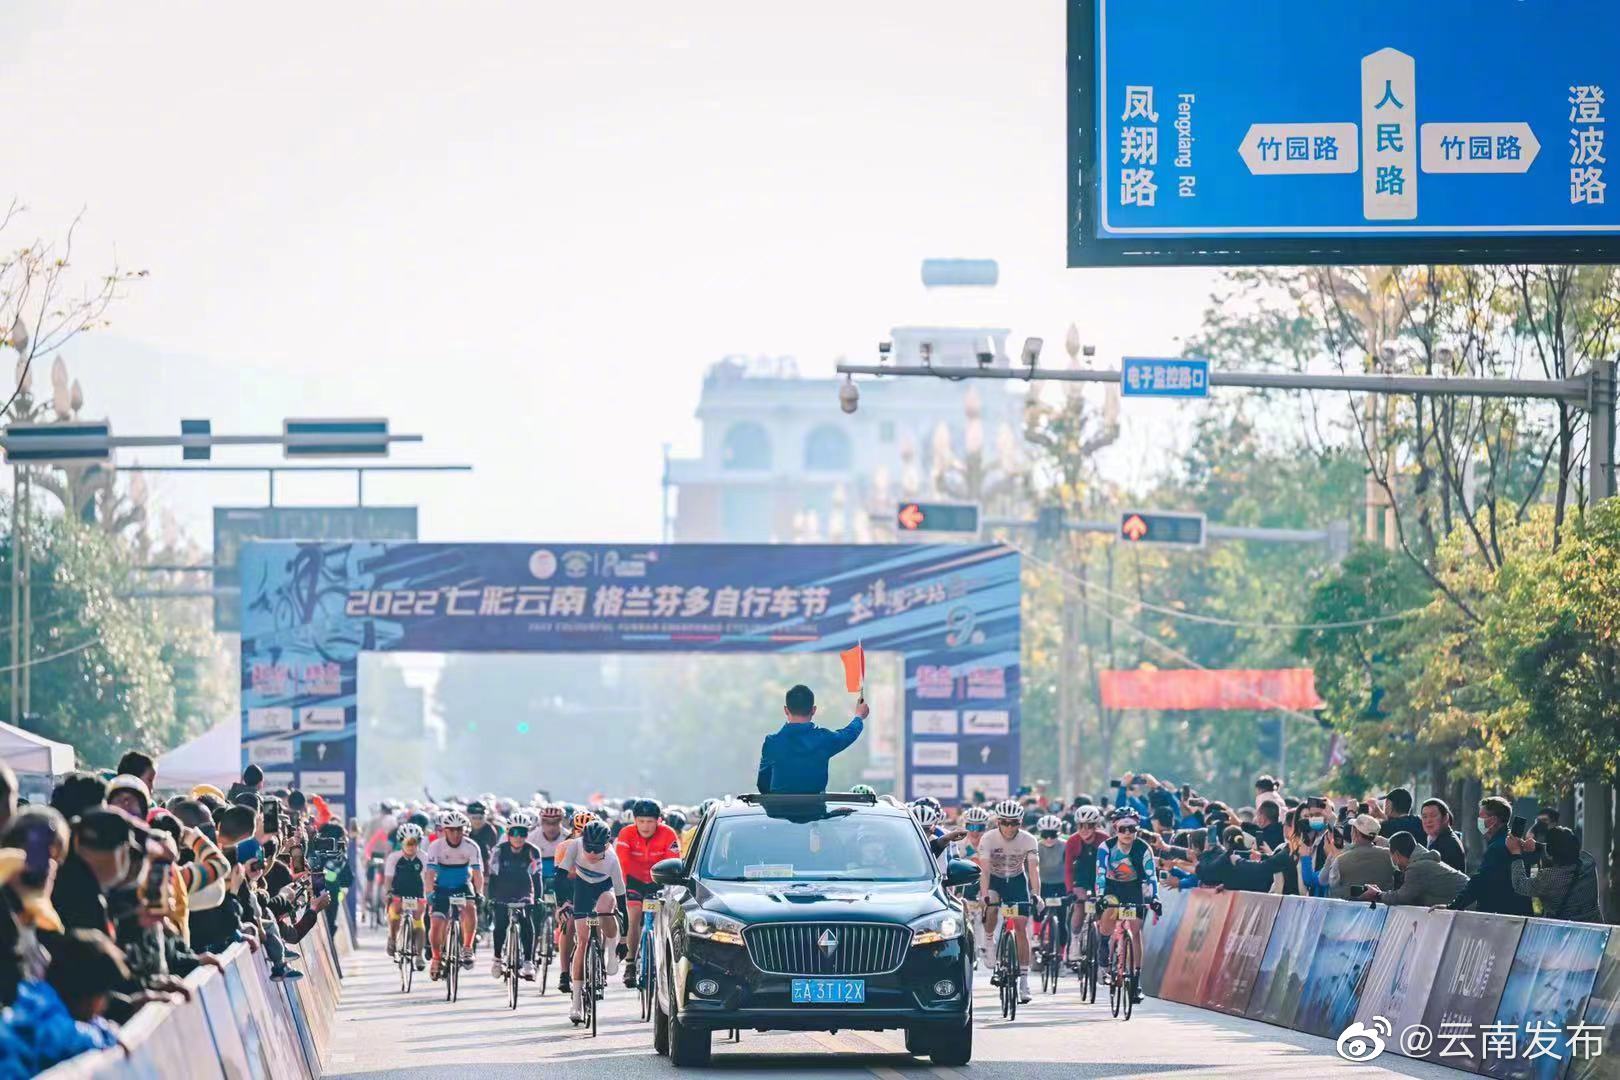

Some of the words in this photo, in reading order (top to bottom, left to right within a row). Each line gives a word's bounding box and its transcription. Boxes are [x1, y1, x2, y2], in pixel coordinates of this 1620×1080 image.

[1120, 85, 1159, 207] 凤翔路
[1174, 93, 1195, 167] Fengxiang
[1257, 136, 1338, 161] 竹园路
[1374, 79, 1405, 195] 人民路
[1440, 135, 1522, 160] 竹园路
[1567, 85, 1607, 205] 澄波路
[1178, 175, 1196, 197] Rd
[592, 585, 831, 618] 格兰芬多自行车节
